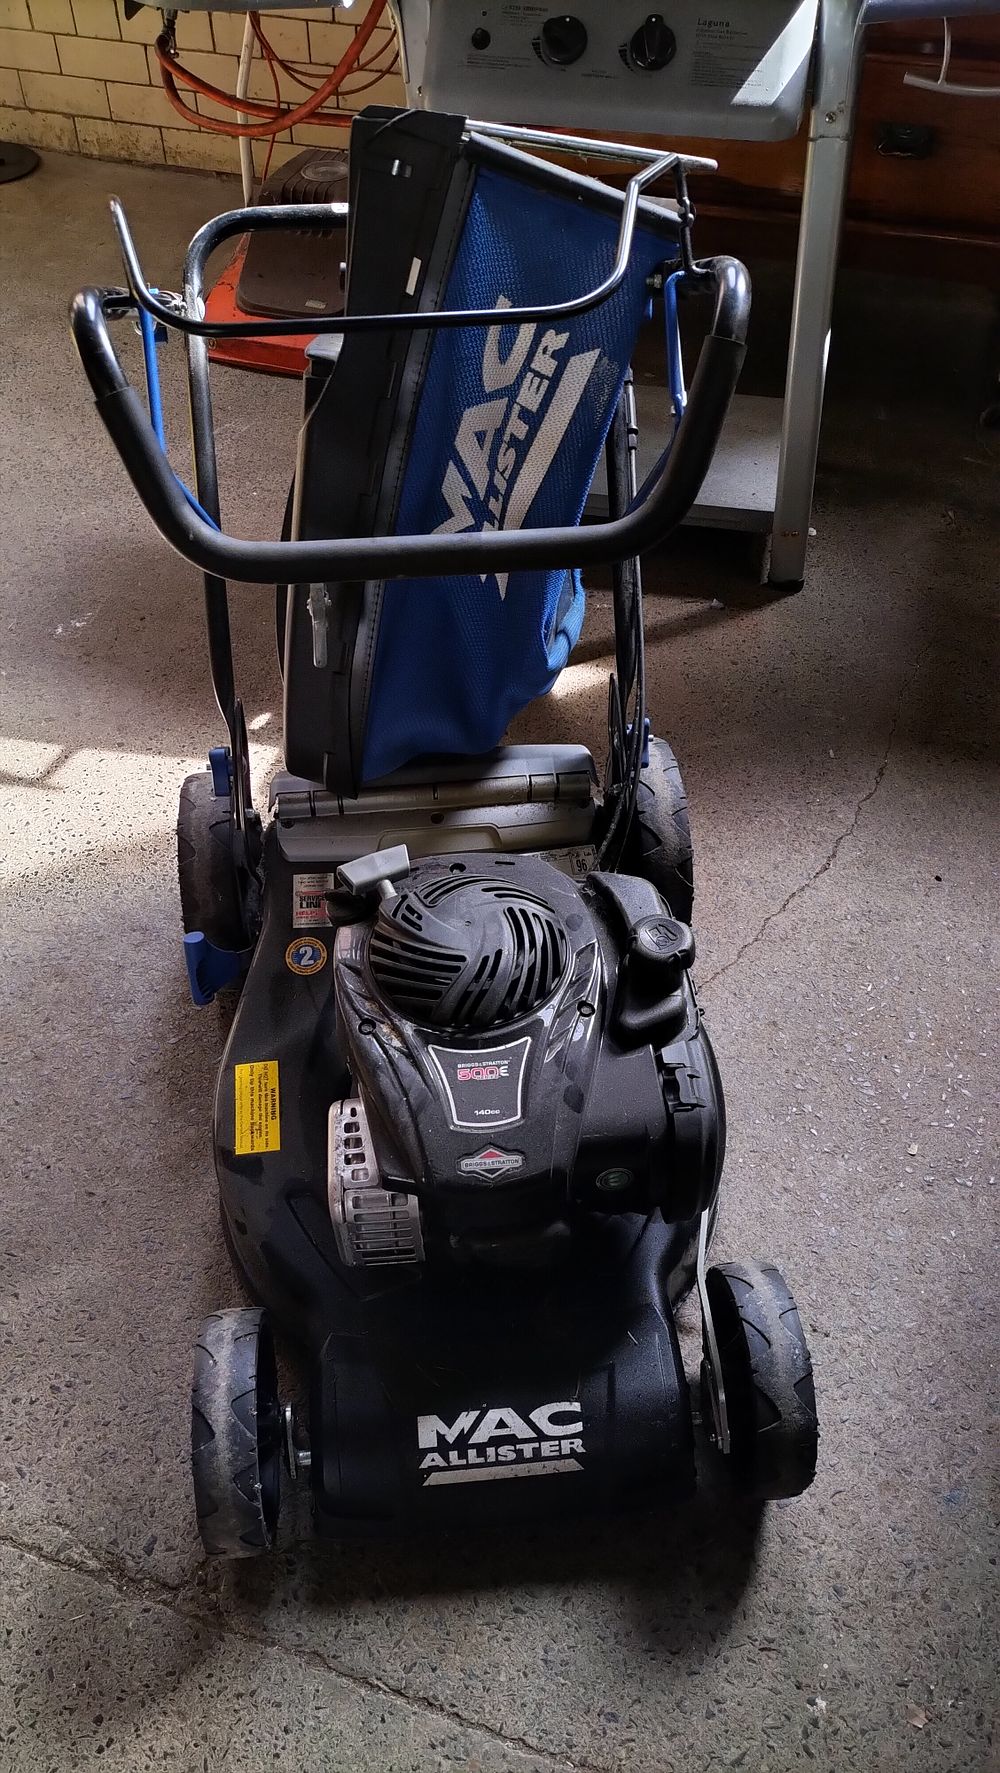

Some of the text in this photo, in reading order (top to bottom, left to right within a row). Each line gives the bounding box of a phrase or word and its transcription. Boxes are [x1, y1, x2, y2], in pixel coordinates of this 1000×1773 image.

[697, 18, 730, 28] Laguna
[575, 858, 588, 872] 96
[299, 946, 314, 966] 2
[457, 1066, 509, 1081] 500E
[416, 1401, 584, 1449] MAC
[418, 1438, 587, 1469] ALLISTER
